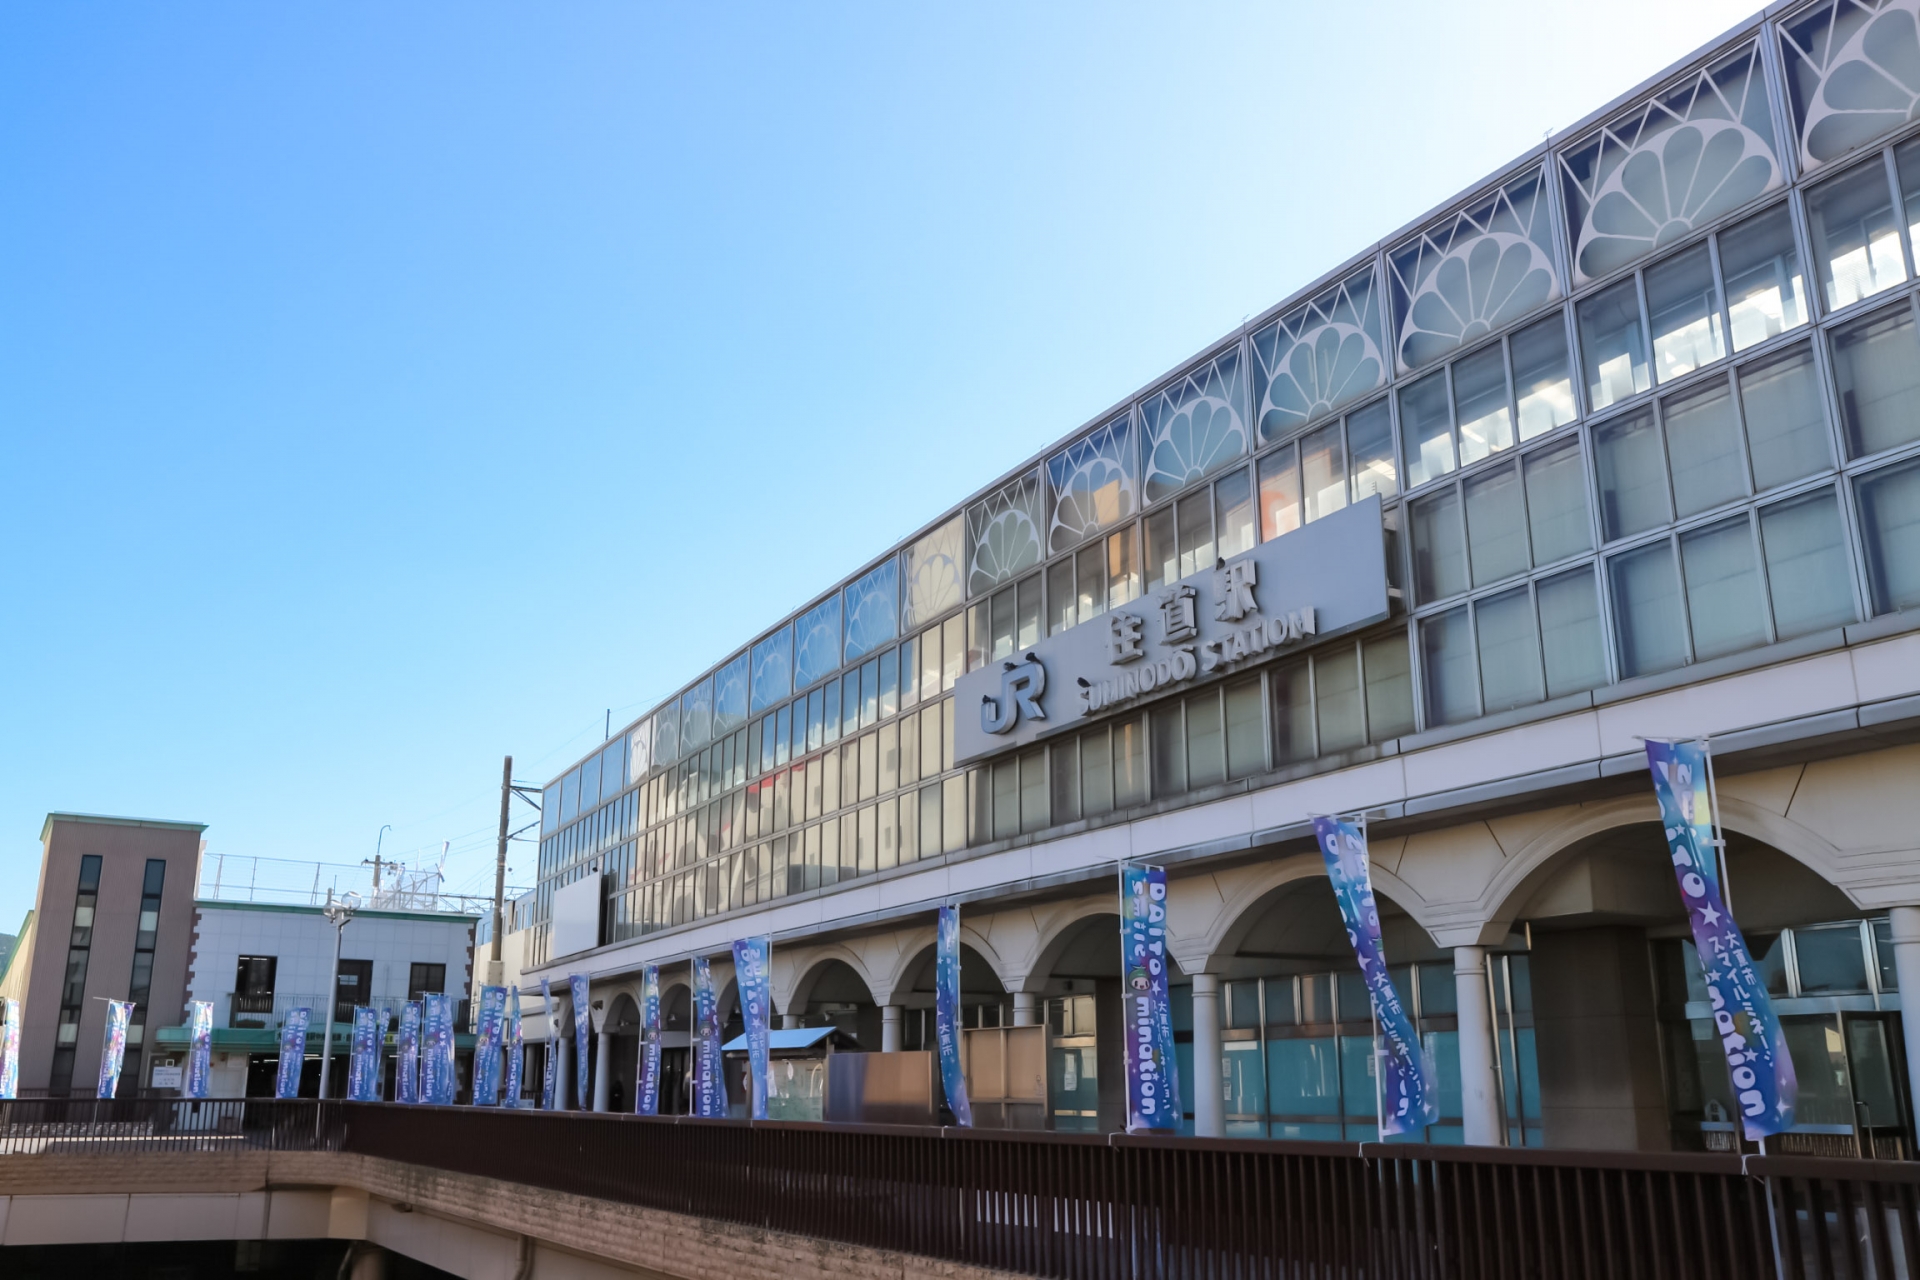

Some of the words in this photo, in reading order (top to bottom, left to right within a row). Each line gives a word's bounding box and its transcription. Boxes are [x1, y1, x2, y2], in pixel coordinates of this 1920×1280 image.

[1202, 606, 1316, 673] STATION
[980, 661, 1047, 735] JR
[702, 1040, 713, 1116] mination
[1136, 996, 1159, 1115] mination
